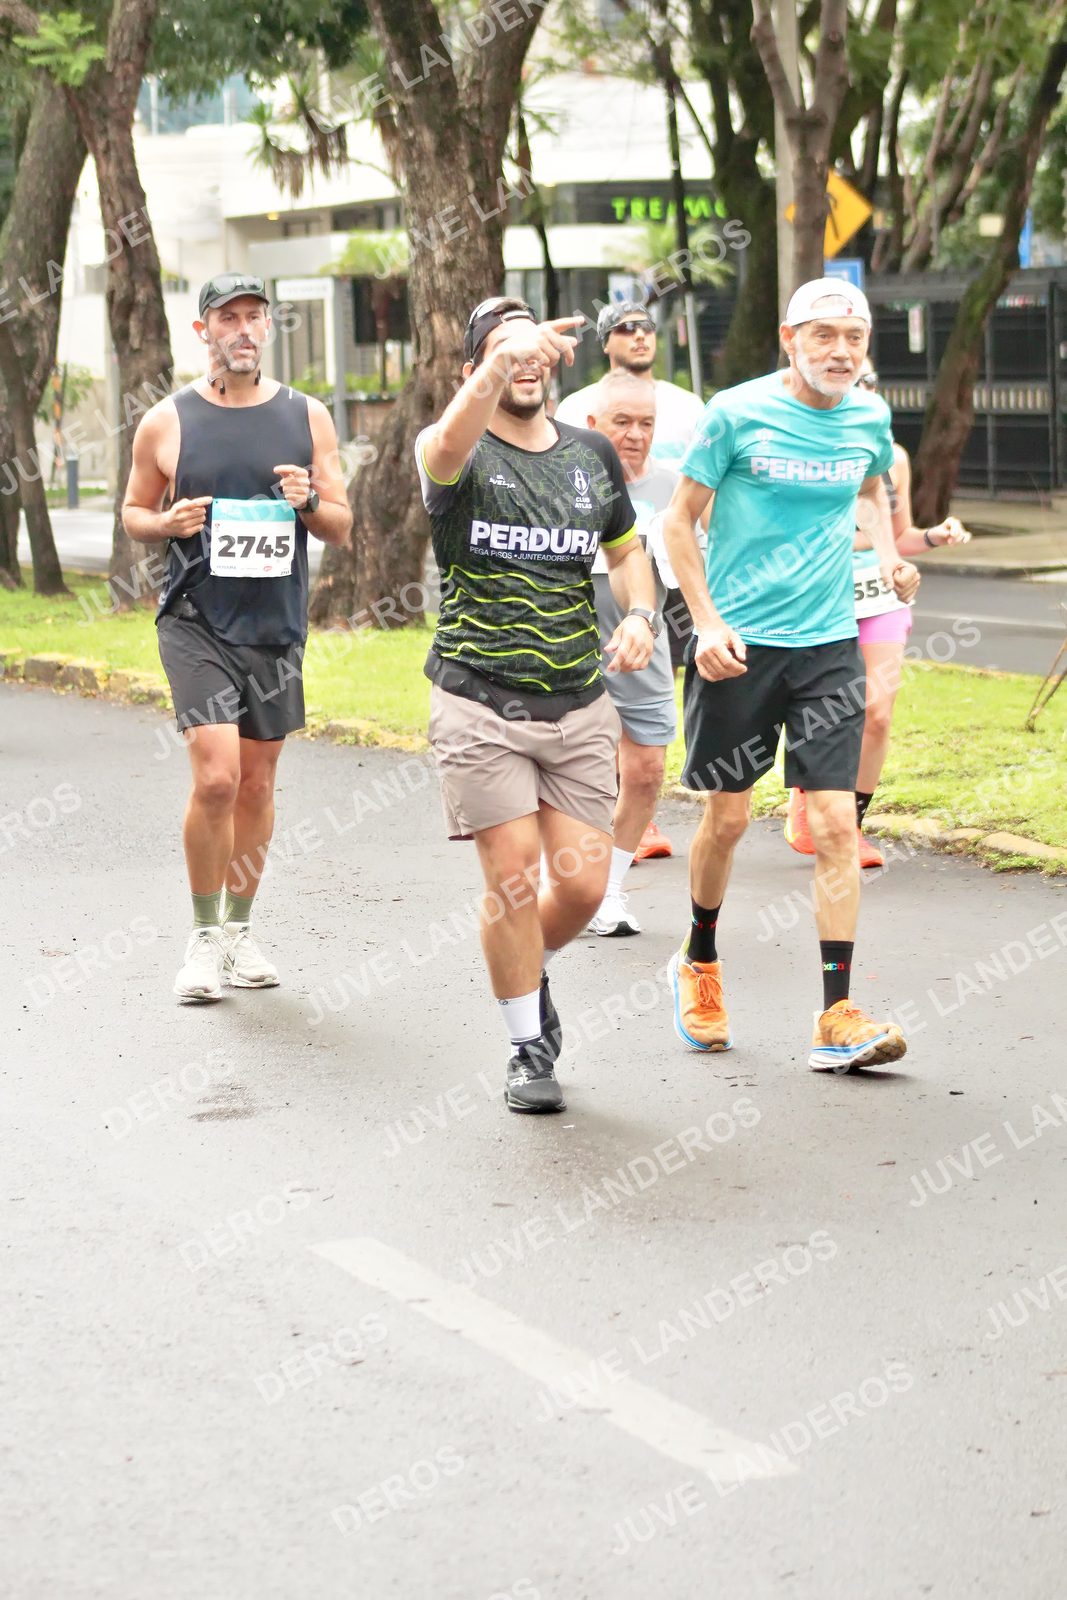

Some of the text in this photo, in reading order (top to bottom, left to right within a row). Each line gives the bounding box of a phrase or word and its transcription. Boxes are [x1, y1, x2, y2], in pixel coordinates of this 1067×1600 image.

[217, 534, 290, 559] 2745
[469, 519, 599, 556] PERDURA
[469, 546, 489, 556] PEGA
[490, 550, 513, 560] PISOS
[517, 553, 570, 562] JUNTEADORES
